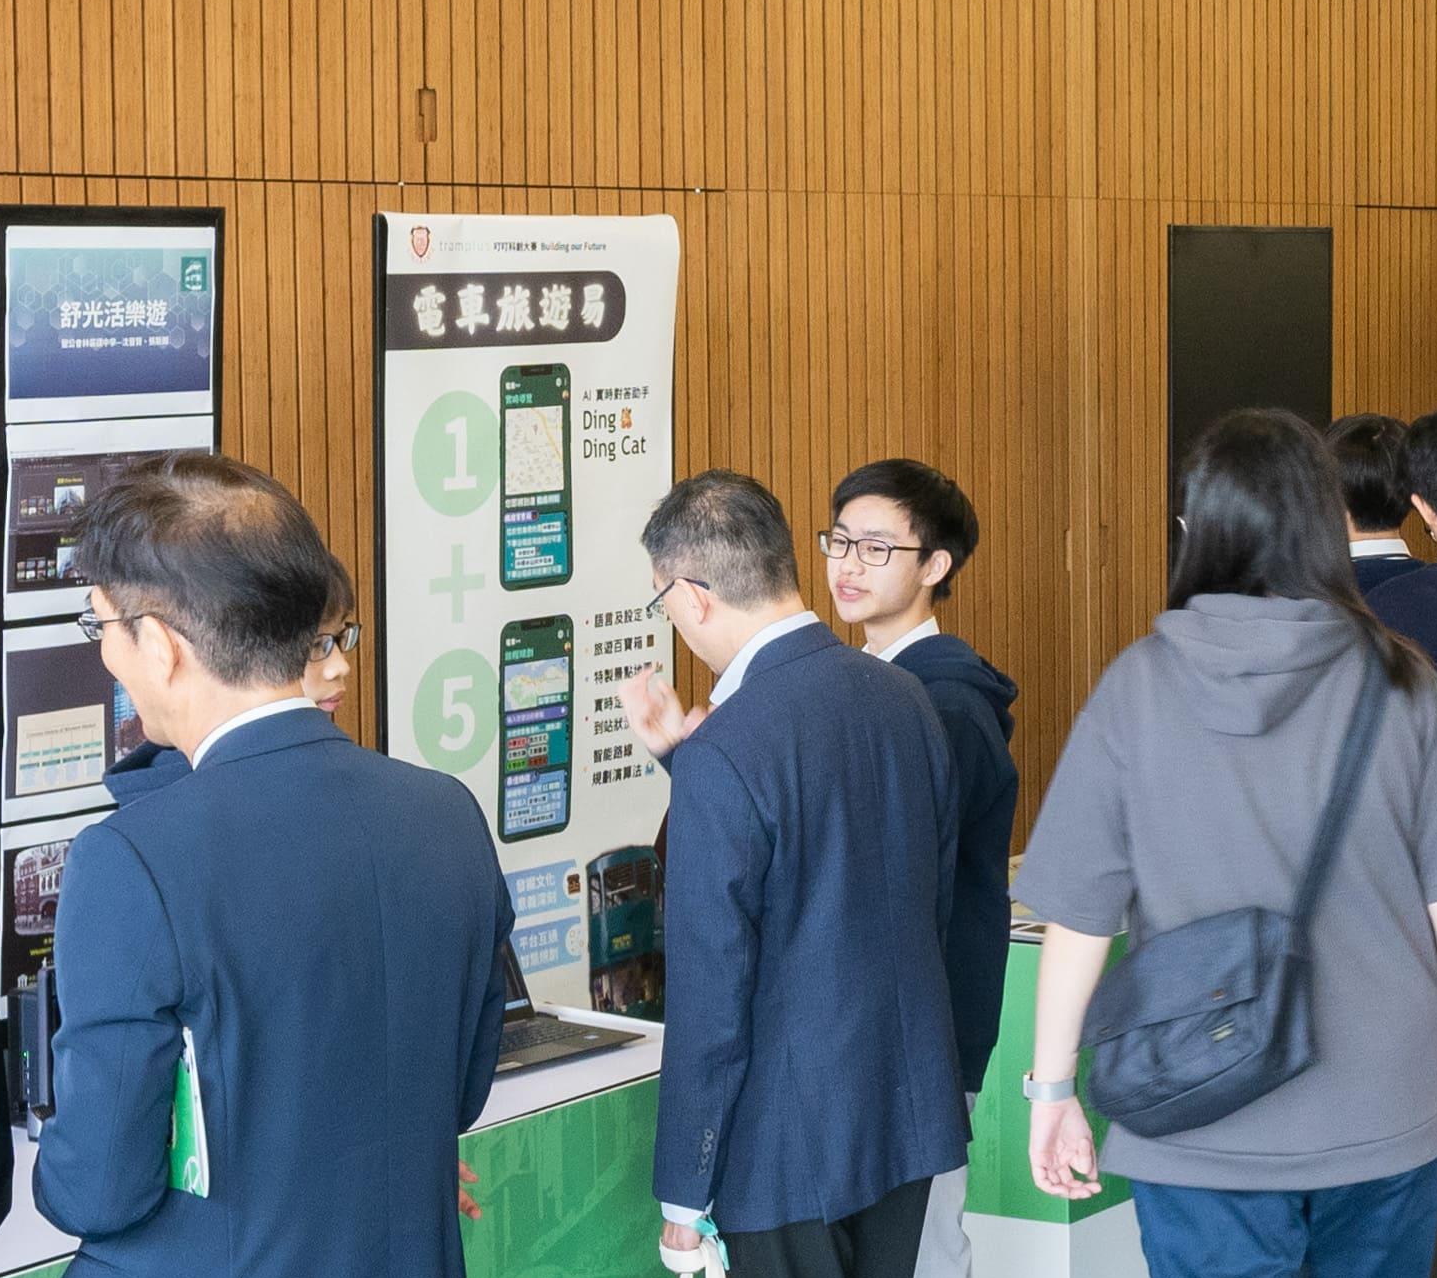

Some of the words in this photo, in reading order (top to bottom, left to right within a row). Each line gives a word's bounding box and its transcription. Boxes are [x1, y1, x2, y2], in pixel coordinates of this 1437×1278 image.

[541, 242, 569, 253] Building
[584, 242, 607, 251] Future
[60, 300, 168, 329] 舒光活樂遊
[413, 283, 606, 337] 電車旅遊易
[582, 390, 592, 401] AI
[595, 386, 649, 401] 實時對答助手
[583, 409, 616, 433] Ding
[442, 415, 478, 492] 1
[583, 438, 616, 462] Ding
[621, 435, 646, 455] Cat
[594, 608, 643, 629] 語言及設定
[594, 636, 643, 656] 旅遊百寶箱
[440, 674, 476, 752] 5
[593, 743, 633, 764] 智能路線
[592, 765, 642, 787] 規劃演算法
